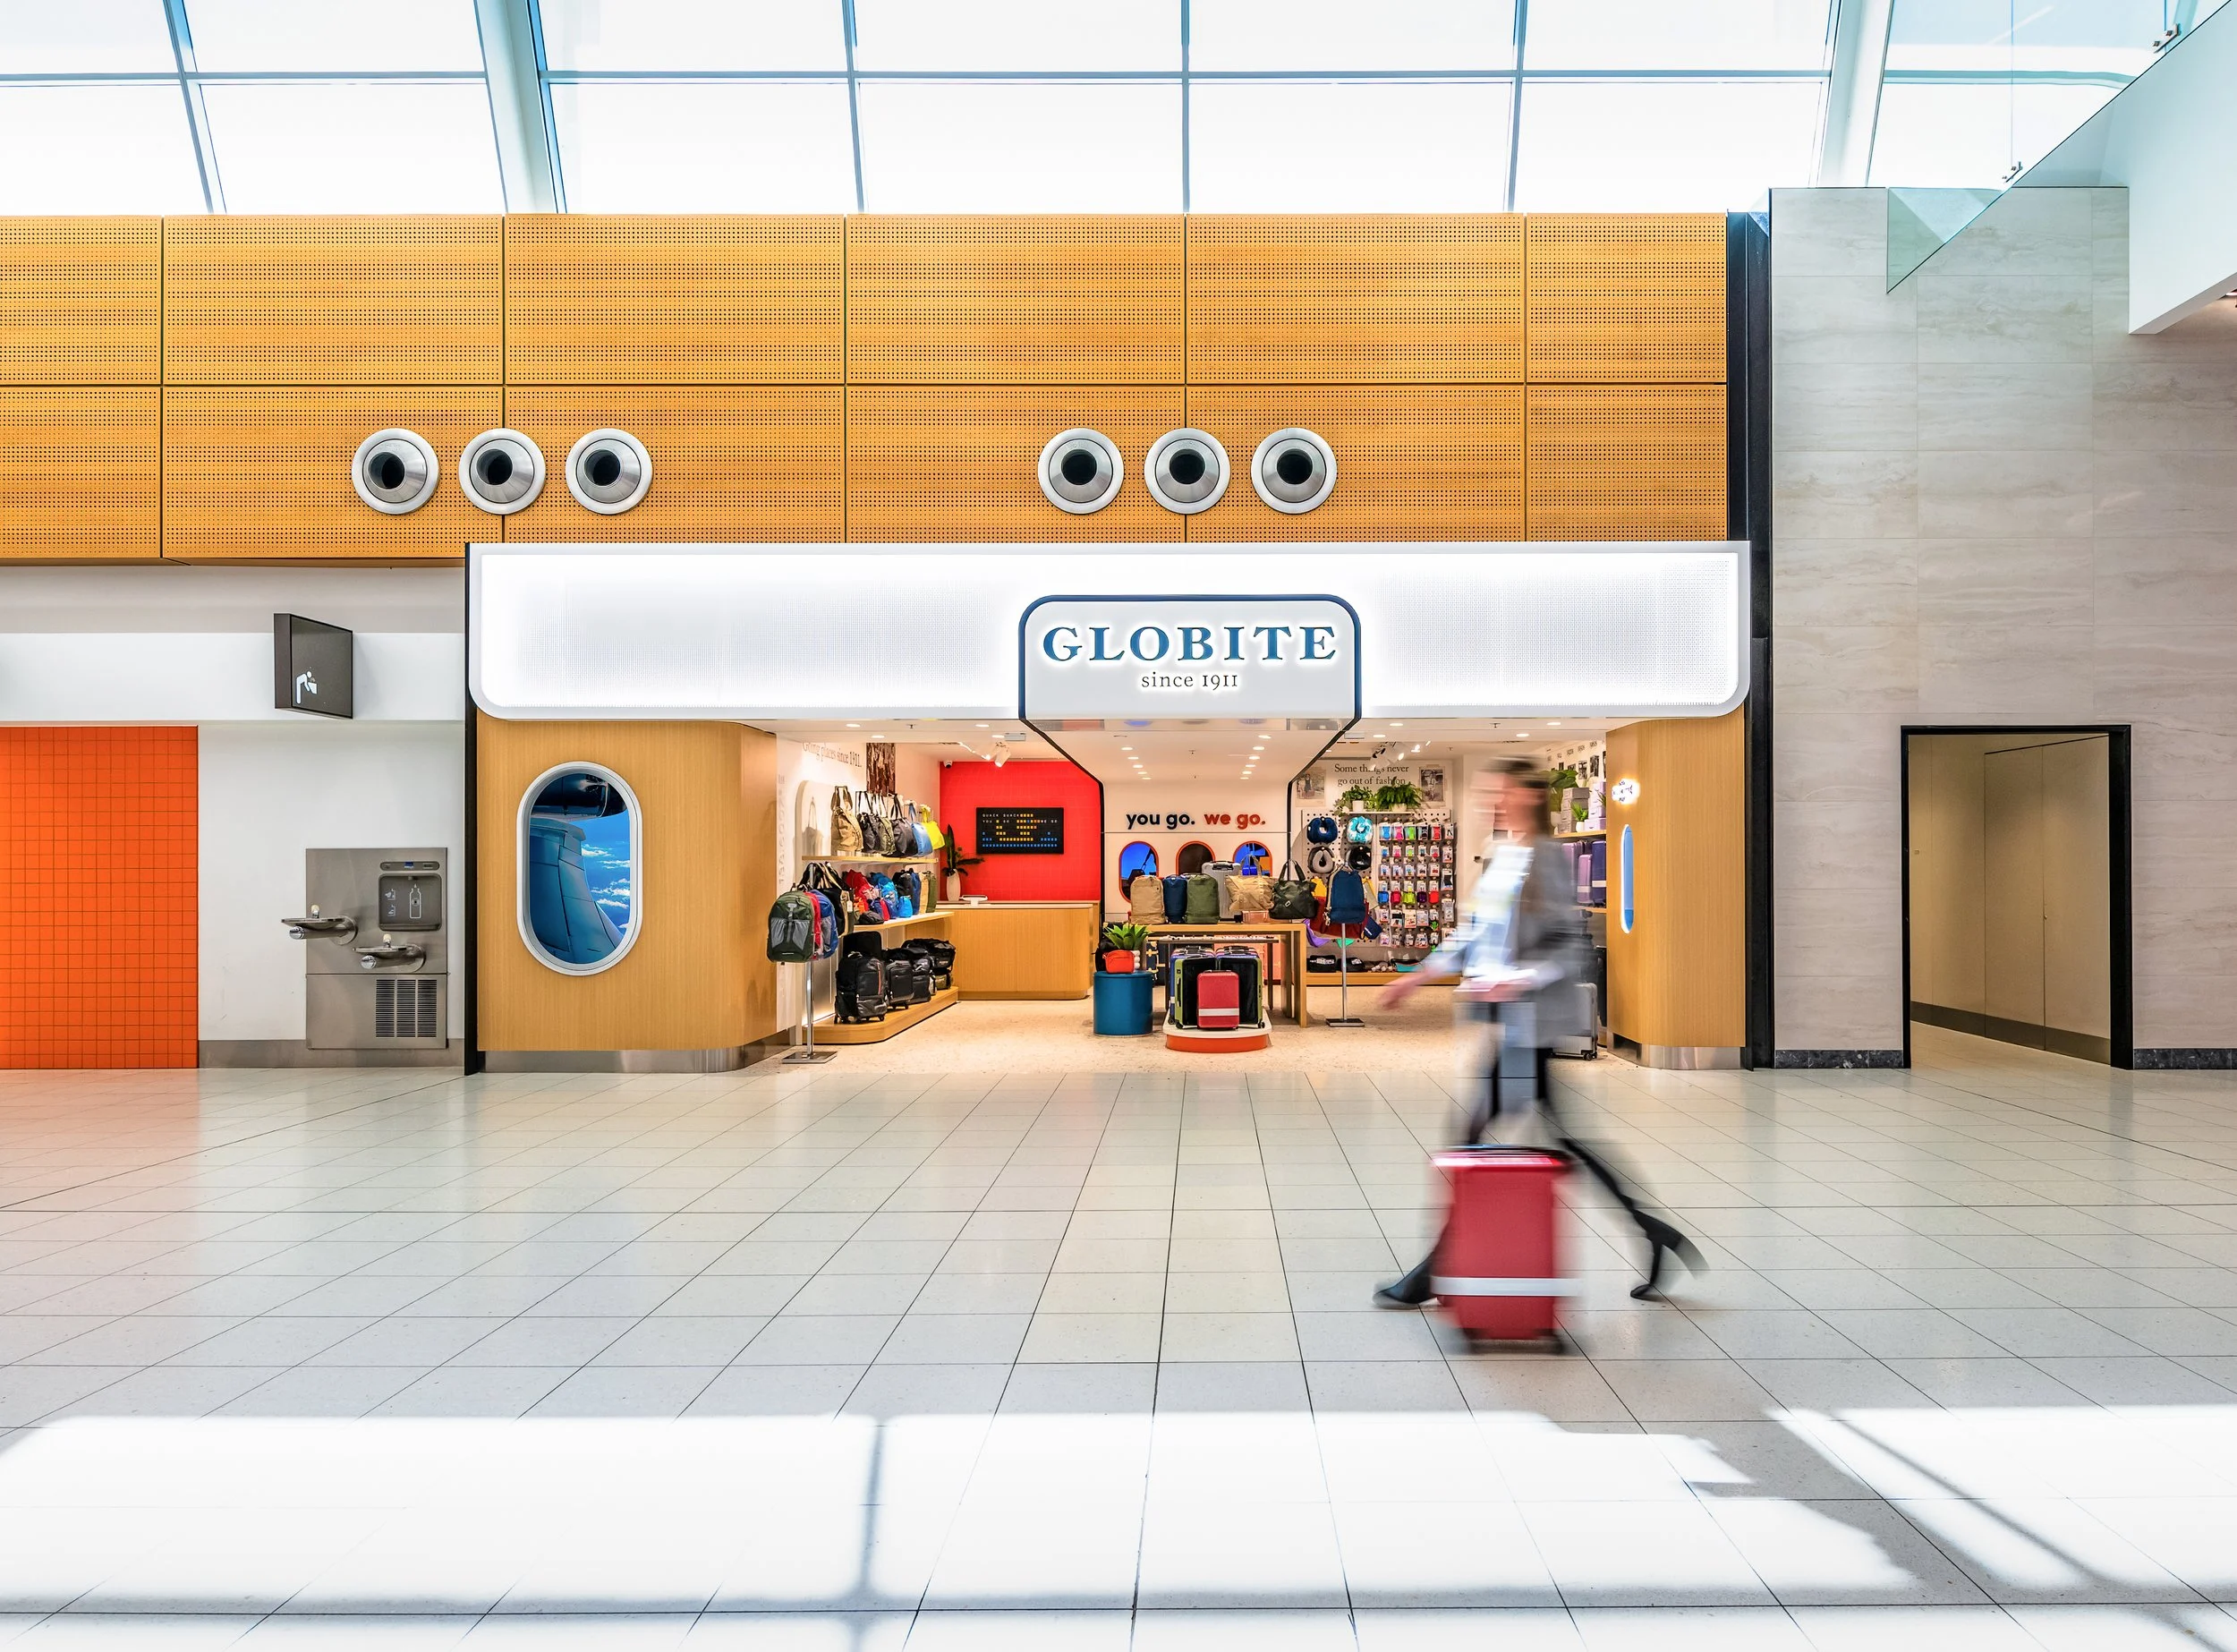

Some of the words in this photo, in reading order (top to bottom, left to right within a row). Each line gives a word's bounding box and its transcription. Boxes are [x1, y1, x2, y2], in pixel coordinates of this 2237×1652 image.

[1042, 626, 1337, 661] GLOBITE
[1141, 671, 1194, 688] since
[1202, 674, 1238, 691] 1911
[1334, 763, 1357, 773] Some
[1359, 763, 1385, 775] thgs
[1338, 779, 1348, 787] go
[1348, 777, 1363, 785] out
[1364, 776, 1374, 785] of
[1375, 776, 1406, 785] fashon
[1126, 813, 1161, 830] you
[1166, 813, 1195, 830] go.
[1204, 813, 1231, 825] we
[1237, 813, 1266, 830] go.
